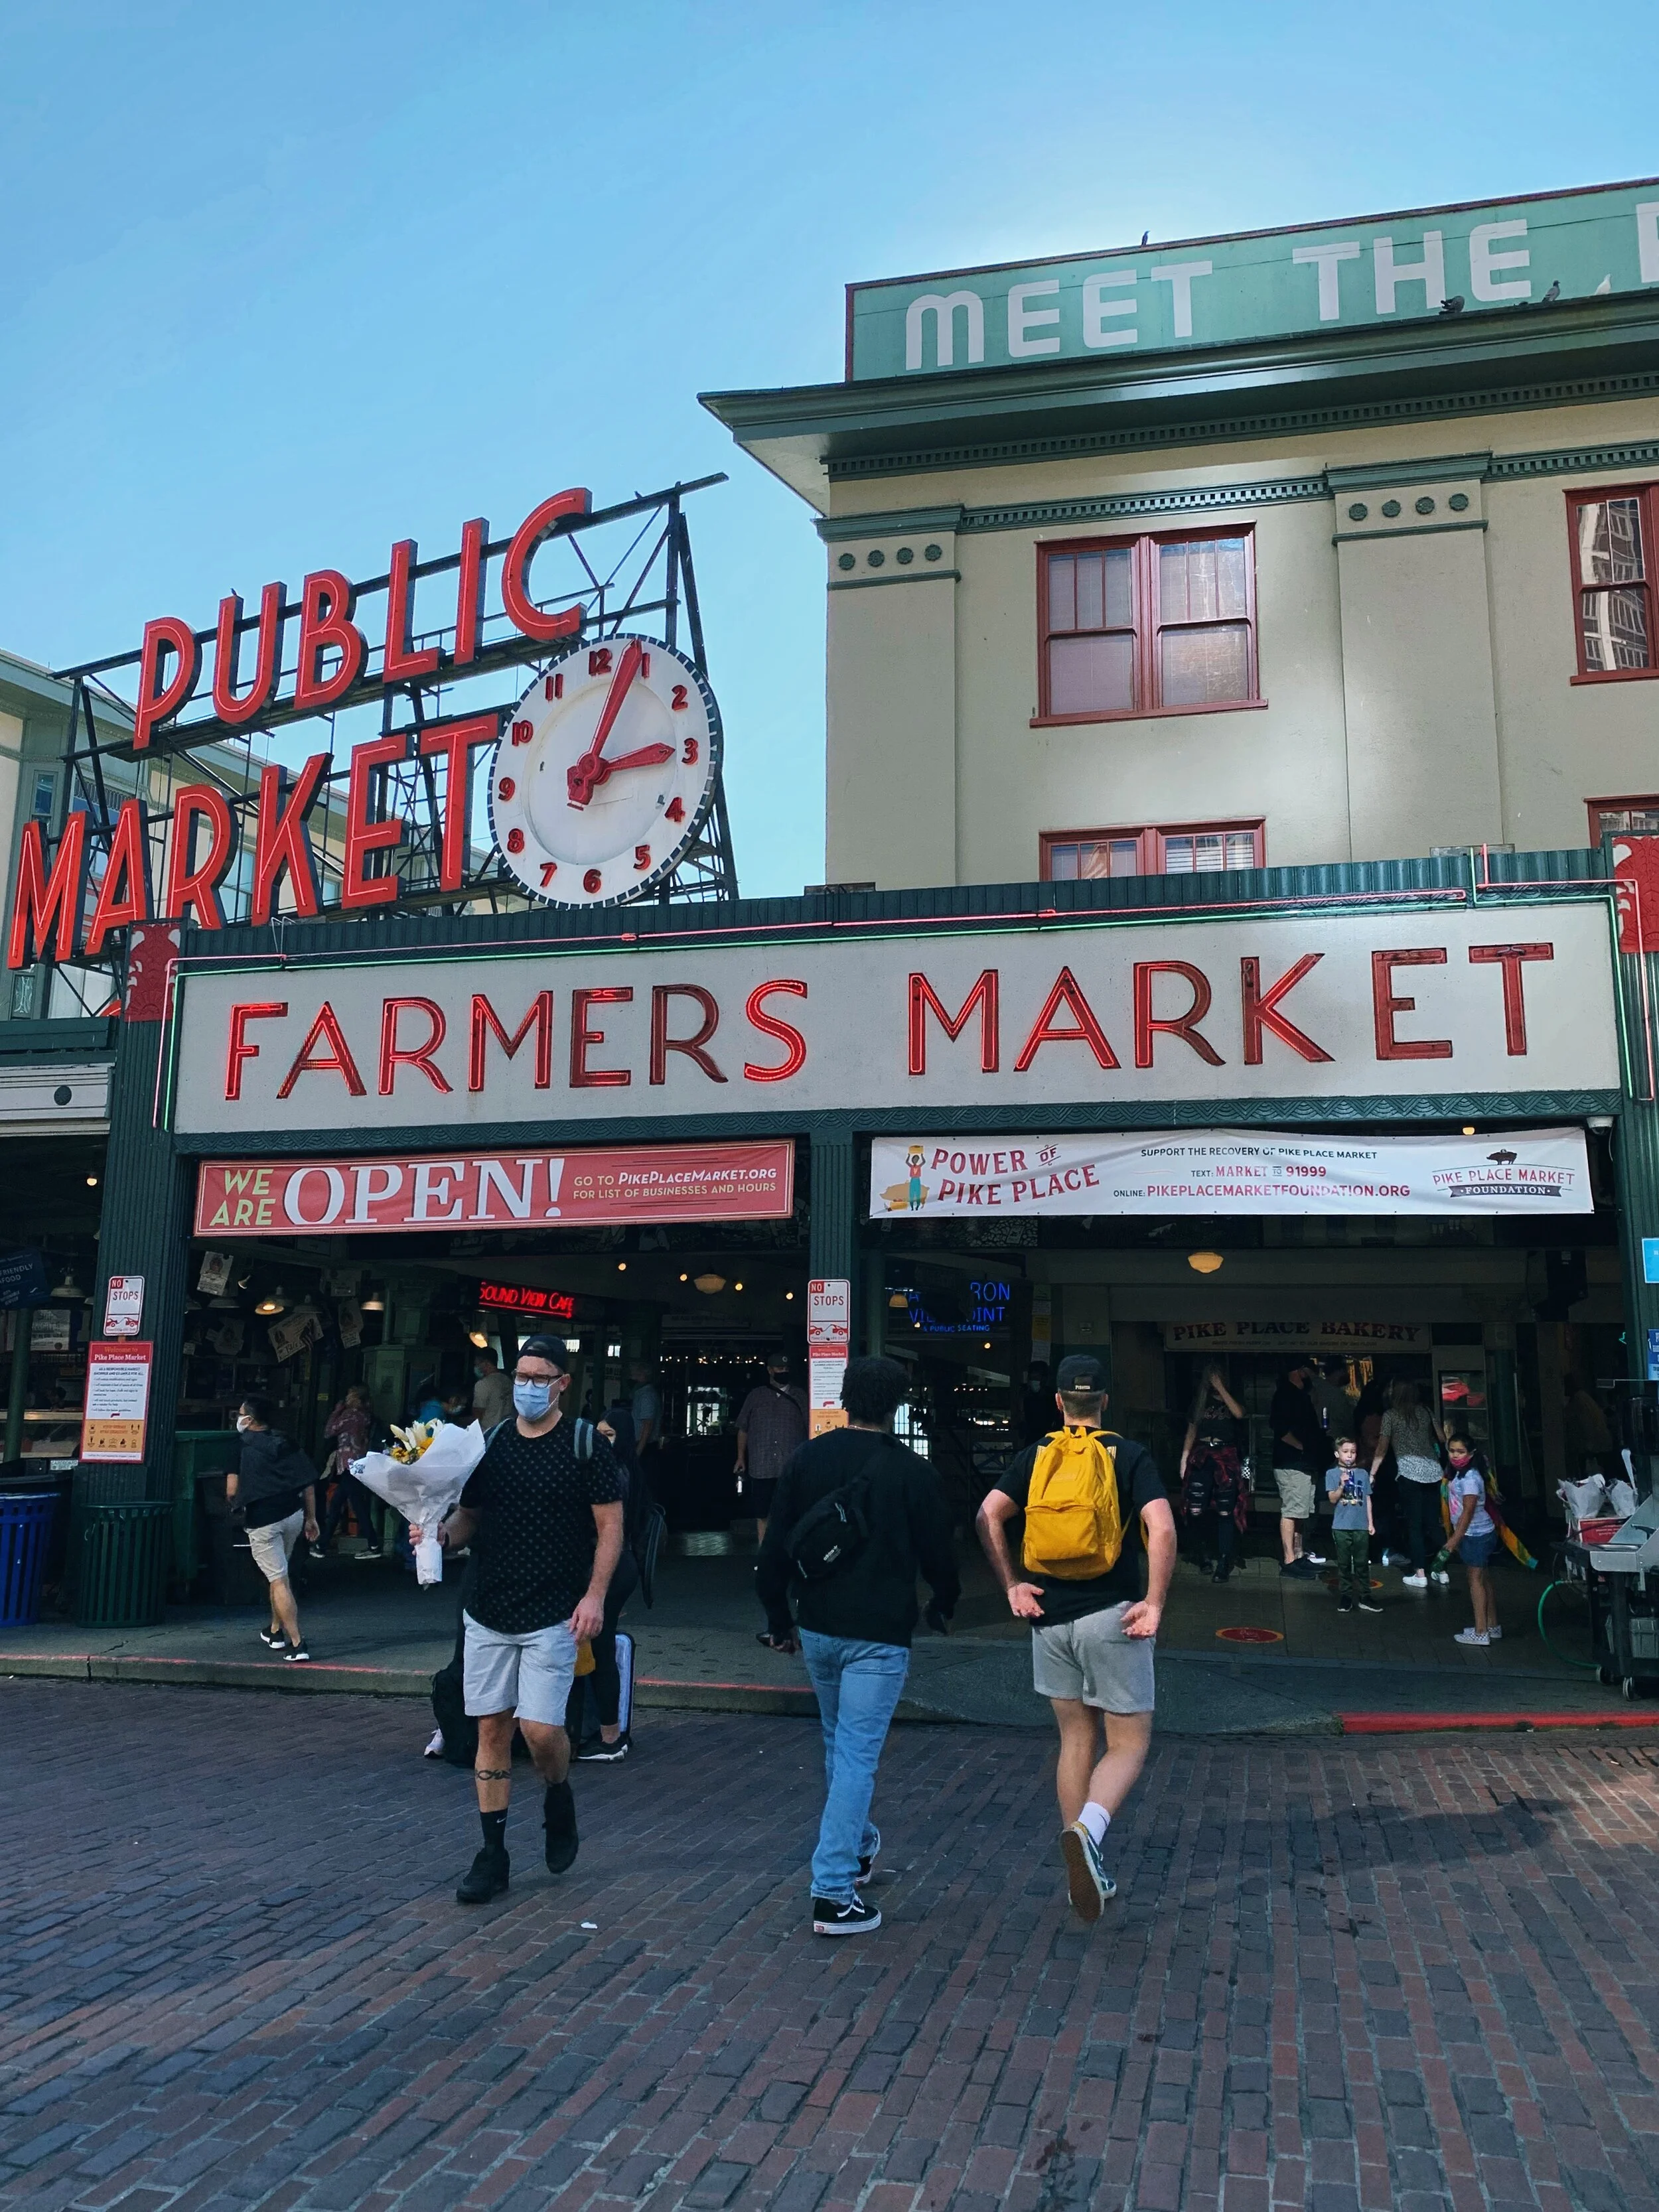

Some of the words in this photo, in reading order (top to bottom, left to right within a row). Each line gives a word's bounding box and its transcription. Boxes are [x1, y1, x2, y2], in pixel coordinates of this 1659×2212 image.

[905, 259, 1214, 370] MEET
[1292, 219, 1532, 322] THE
[134, 487, 593, 750] PUBLIC
[589, 648, 612, 675] 12
[545, 674, 563, 701] 11
[672, 684, 689, 711] 2
[512, 721, 533, 746] 10
[682, 738, 698, 764] 3
[498, 776, 515, 802] 9
[665, 796, 684, 823] 4
[7, 712, 500, 970] MARKET
[506, 828, 525, 854] 8
[634, 844, 651, 870] 5
[540, 862, 557, 888] 7
[583, 869, 601, 894] 6
[225, 979, 808, 1101] FARMERS
[908, 941, 1555, 1075] MARKET
[930, 1148, 1028, 1176] POWER
[1039, 1146, 1058, 1162] OF
[1141, 1147, 1186, 1157] SUPPORT
[1188, 1147, 1207, 1156] THE
[1209, 1146, 1260, 1156] RECOVERY
[1278, 1148, 1301, 1157] PIKE
[1303, 1149, 1335, 1158] PLACE
[1336, 1150, 1378, 1160] MARKET
[224, 1168, 274, 1195] WE
[574, 1176, 593, 1186] GO
[597, 1175, 614, 1186] TO
[937, 1178, 1001, 1205] PIKE
[1011, 1164, 1100, 1202] PLACE
[1191, 1169, 1214, 1178] TEXT:
[1216, 1165, 1267, 1178] MARKET
[1272, 1166, 1282, 1176] TO
[1286, 1166, 1327, 1177] 91999
[1433, 1172, 1464, 1186] PIKE
[1468, 1168, 1512, 1182] PLACE
[1518, 1168, 1575, 1185] MARKET
[283, 1157, 565, 1225] OPEN!
[573, 1190, 595, 1200] FOR
[598, 1189, 620, 1199] LIST
[624, 1188, 640, 1198] OF
[642, 1185, 707, 1198] BUSINESSES
[711, 1184, 735, 1195] AND
[737, 1182, 776, 1193] HOURS
[1113, 1189, 1145, 1198] ONLINE:
[1147, 1184, 1410, 1197] PIKEPLACEMARKETFOUNDATION.ORG
[1465, 1186, 1546, 1195] FOUNDATION
[209, 1198, 276, 1227] ARE
[111, 1279, 122, 1288] NO
[112, 1291, 139, 1301] STOPS
[479, 1282, 518, 1304] SOUND
[811, 1283, 823, 1292] NO
[814, 1296, 844, 1306] STOPS
[1174, 1322, 1227, 1341] PIKE
[1237, 1322, 1311, 1336] PLACE
[1320, 1322, 1421, 1342] BAKERY
